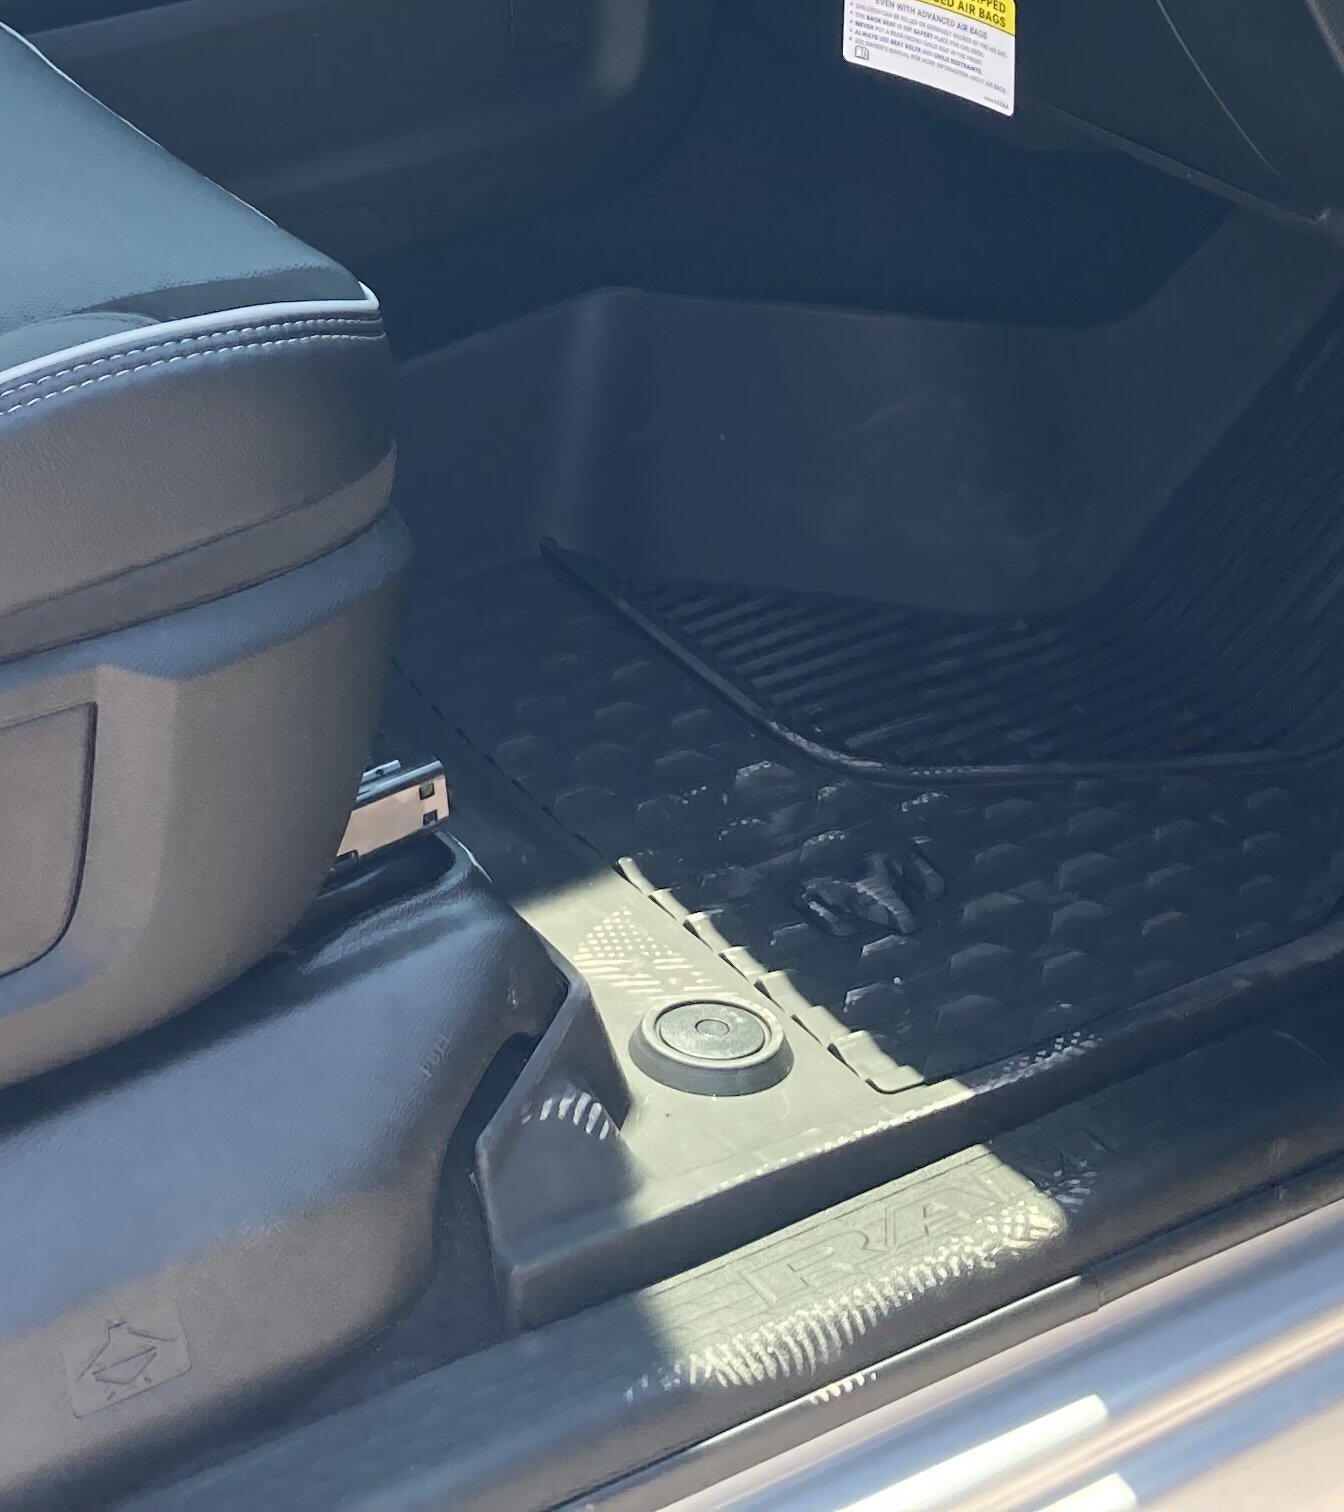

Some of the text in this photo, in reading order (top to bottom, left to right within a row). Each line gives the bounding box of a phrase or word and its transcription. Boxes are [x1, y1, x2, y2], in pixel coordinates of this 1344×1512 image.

[896, 3, 916, 14] WITH
[917, 9, 956, 28] ADVANCED
[956, 22, 969, 31] AIR
[957, 0, 976, 16] AIR
[978, 7, 1006, 28] BAGS
